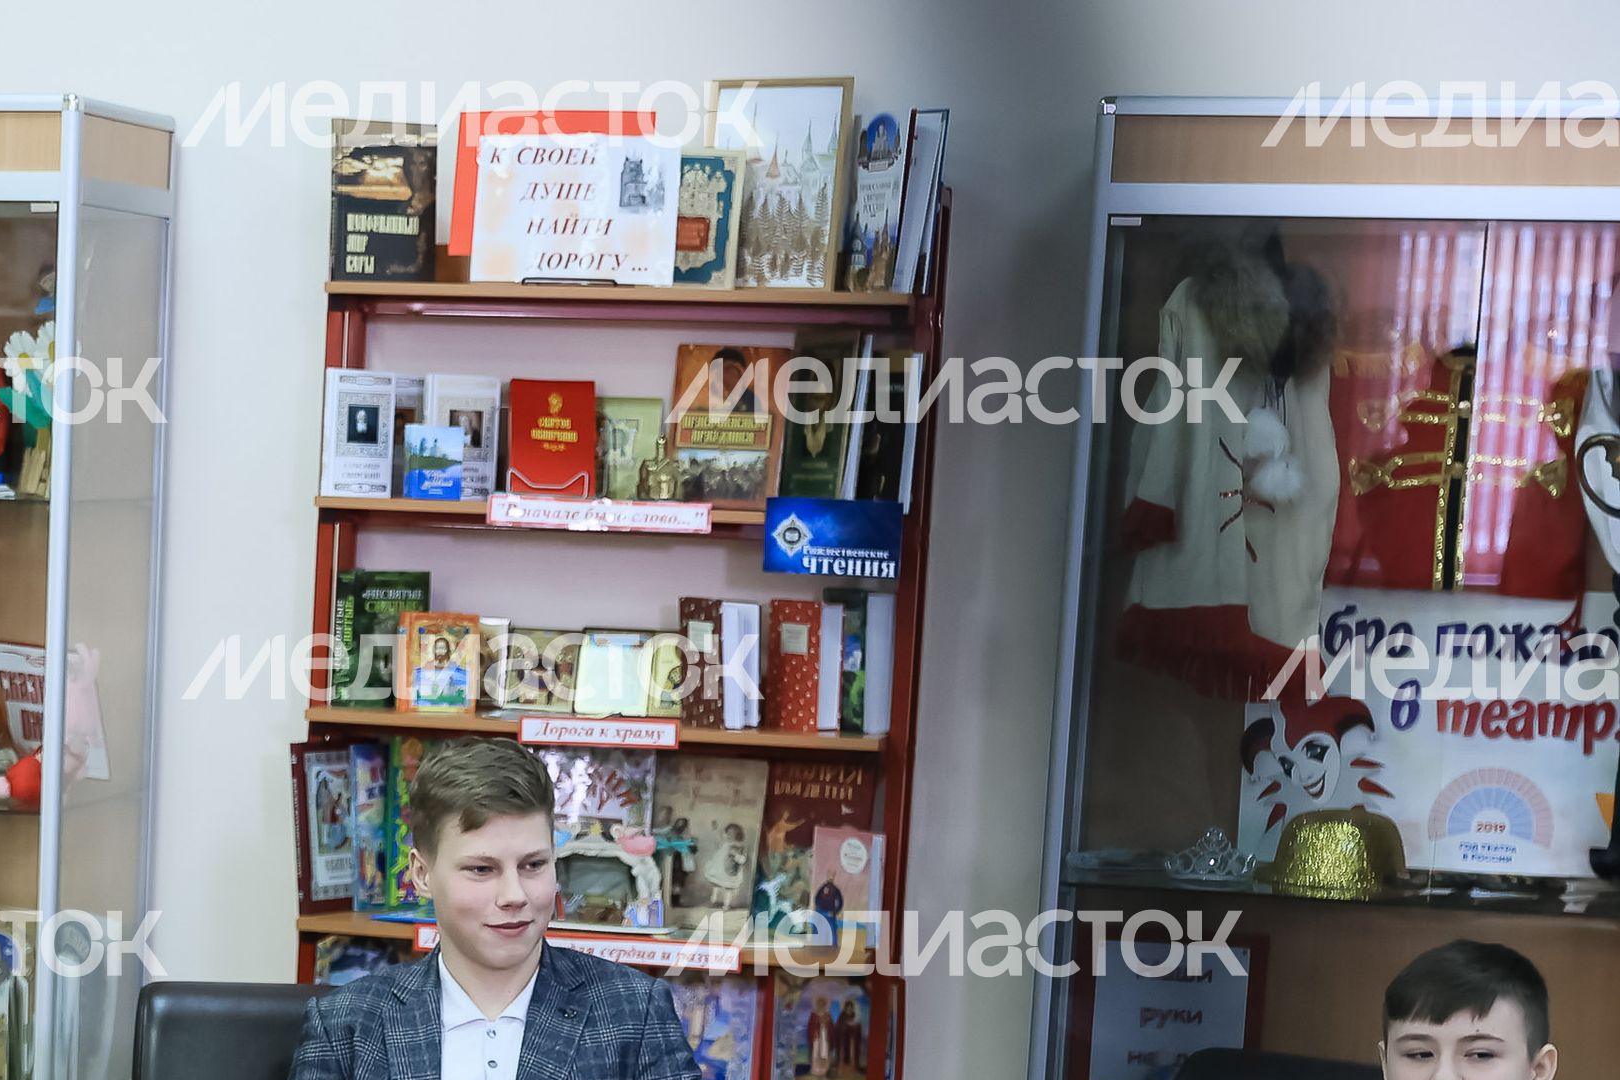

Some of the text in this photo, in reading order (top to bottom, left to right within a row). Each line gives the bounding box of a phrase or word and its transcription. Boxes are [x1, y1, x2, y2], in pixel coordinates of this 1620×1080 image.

[517, 144, 598, 166] СВОЕЙ
[519, 182, 598, 203] ДУШЕ
[526, 213, 613, 235] НАЙТИ
[1319, 604, 1415, 670] бро
[1390, 679, 1620, 756] в театр
[535, 721, 666, 744] Дорога к храму
[1476, 821, 1506, 833] 2019
[599, 946, 655, 963] сердца
[661, 952, 672, 961] и
[675, 951, 735, 967] разума
[1139, 1006, 1203, 1029] руки
